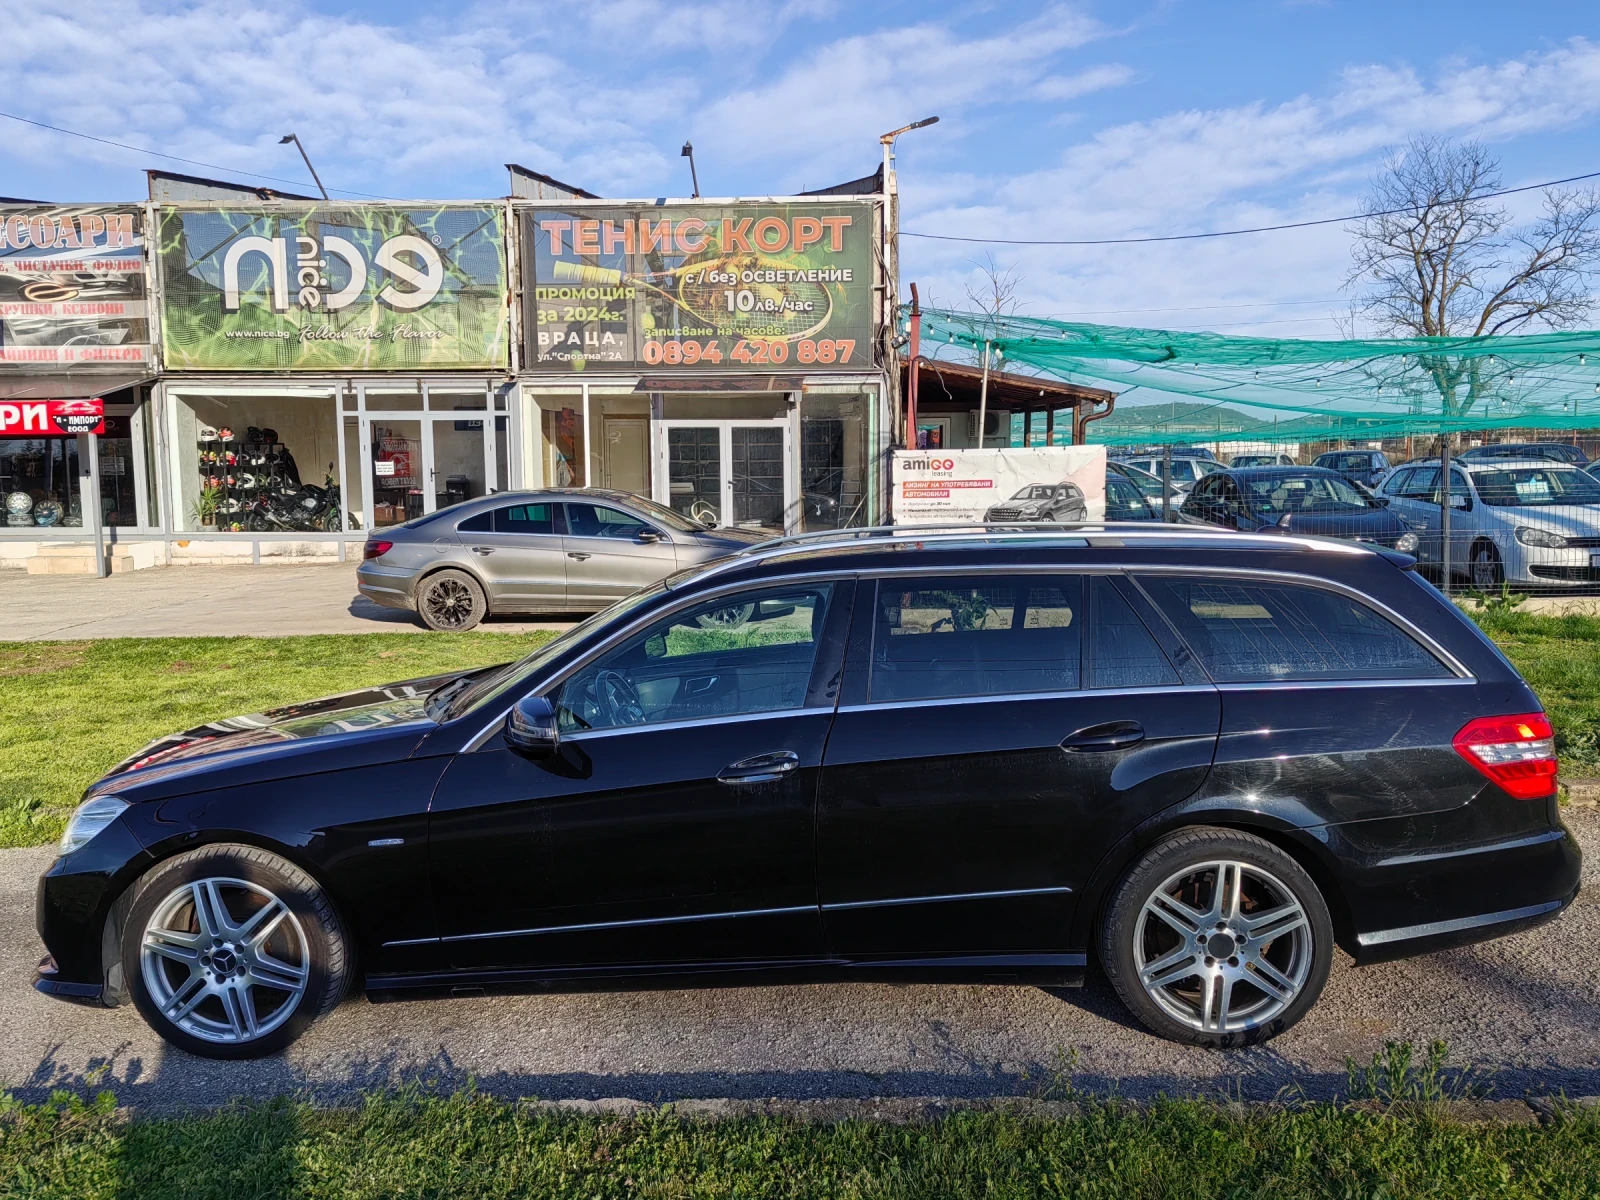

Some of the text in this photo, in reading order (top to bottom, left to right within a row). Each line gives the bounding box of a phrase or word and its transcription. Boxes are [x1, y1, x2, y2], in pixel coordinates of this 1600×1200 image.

[0, 214, 135, 249] СОАРИ
[540, 215, 852, 255] ТЕНИС КОРТ
[93, 259, 141, 273] ФОЛИО
[685, 272, 695, 284] с
[709, 270, 738, 286] без
[741, 269, 853, 283] ОСВЕТЛЕНИЕ
[535, 287, 636, 302] ПРОМОЦИЯ
[62, 303, 125, 315] КСЕНОНИ
[537, 306, 624, 325] за 2024г.
[225, 323, 445, 343] www.nice.bg Follow the Flavor
[537, 331, 623, 347] ВРАЦА,
[644, 326, 785, 338] записване на часове:
[80, 348, 143, 361] ФИЛТРИ
[642, 339, 856, 365] 0894 420 887
